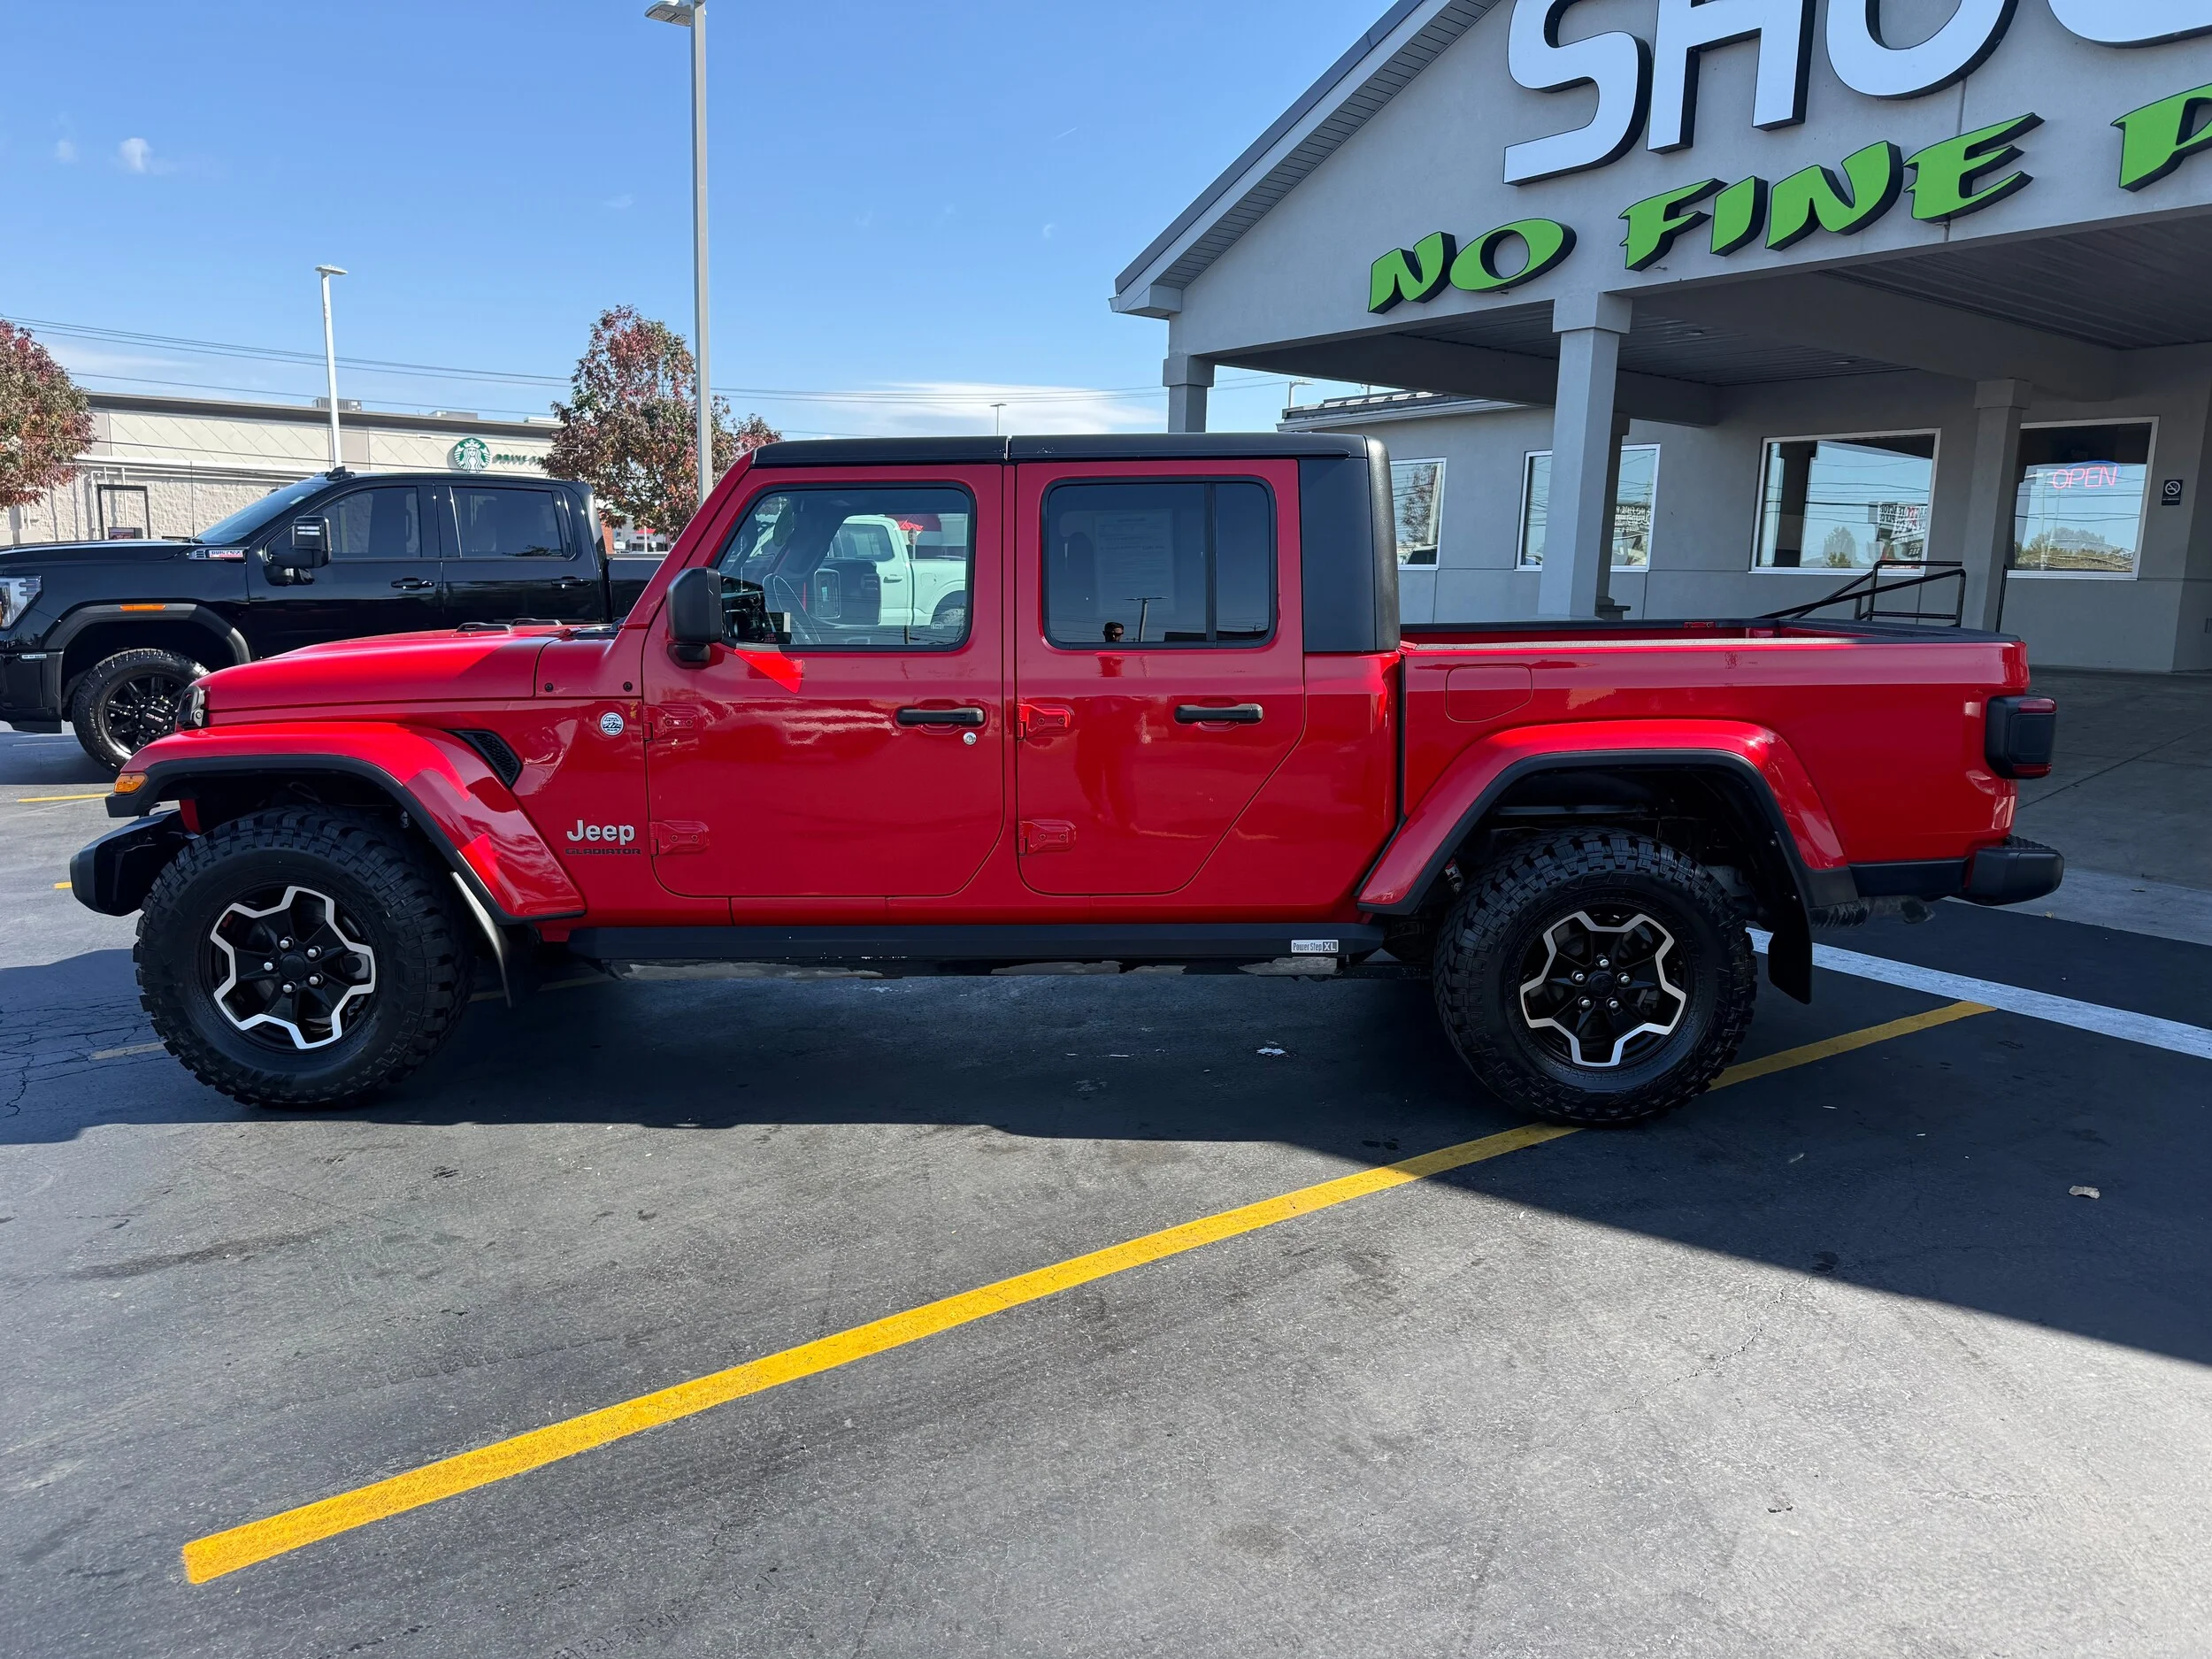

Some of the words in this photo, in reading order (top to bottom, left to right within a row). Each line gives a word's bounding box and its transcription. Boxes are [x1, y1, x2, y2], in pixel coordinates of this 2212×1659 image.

[1368, 219, 1577, 314] NO
[1618, 112, 2045, 271] FINE
[2053, 465, 2118, 489] OPEN
[566, 818, 635, 846] Jeep
[1324, 941, 1336, 951] XL
